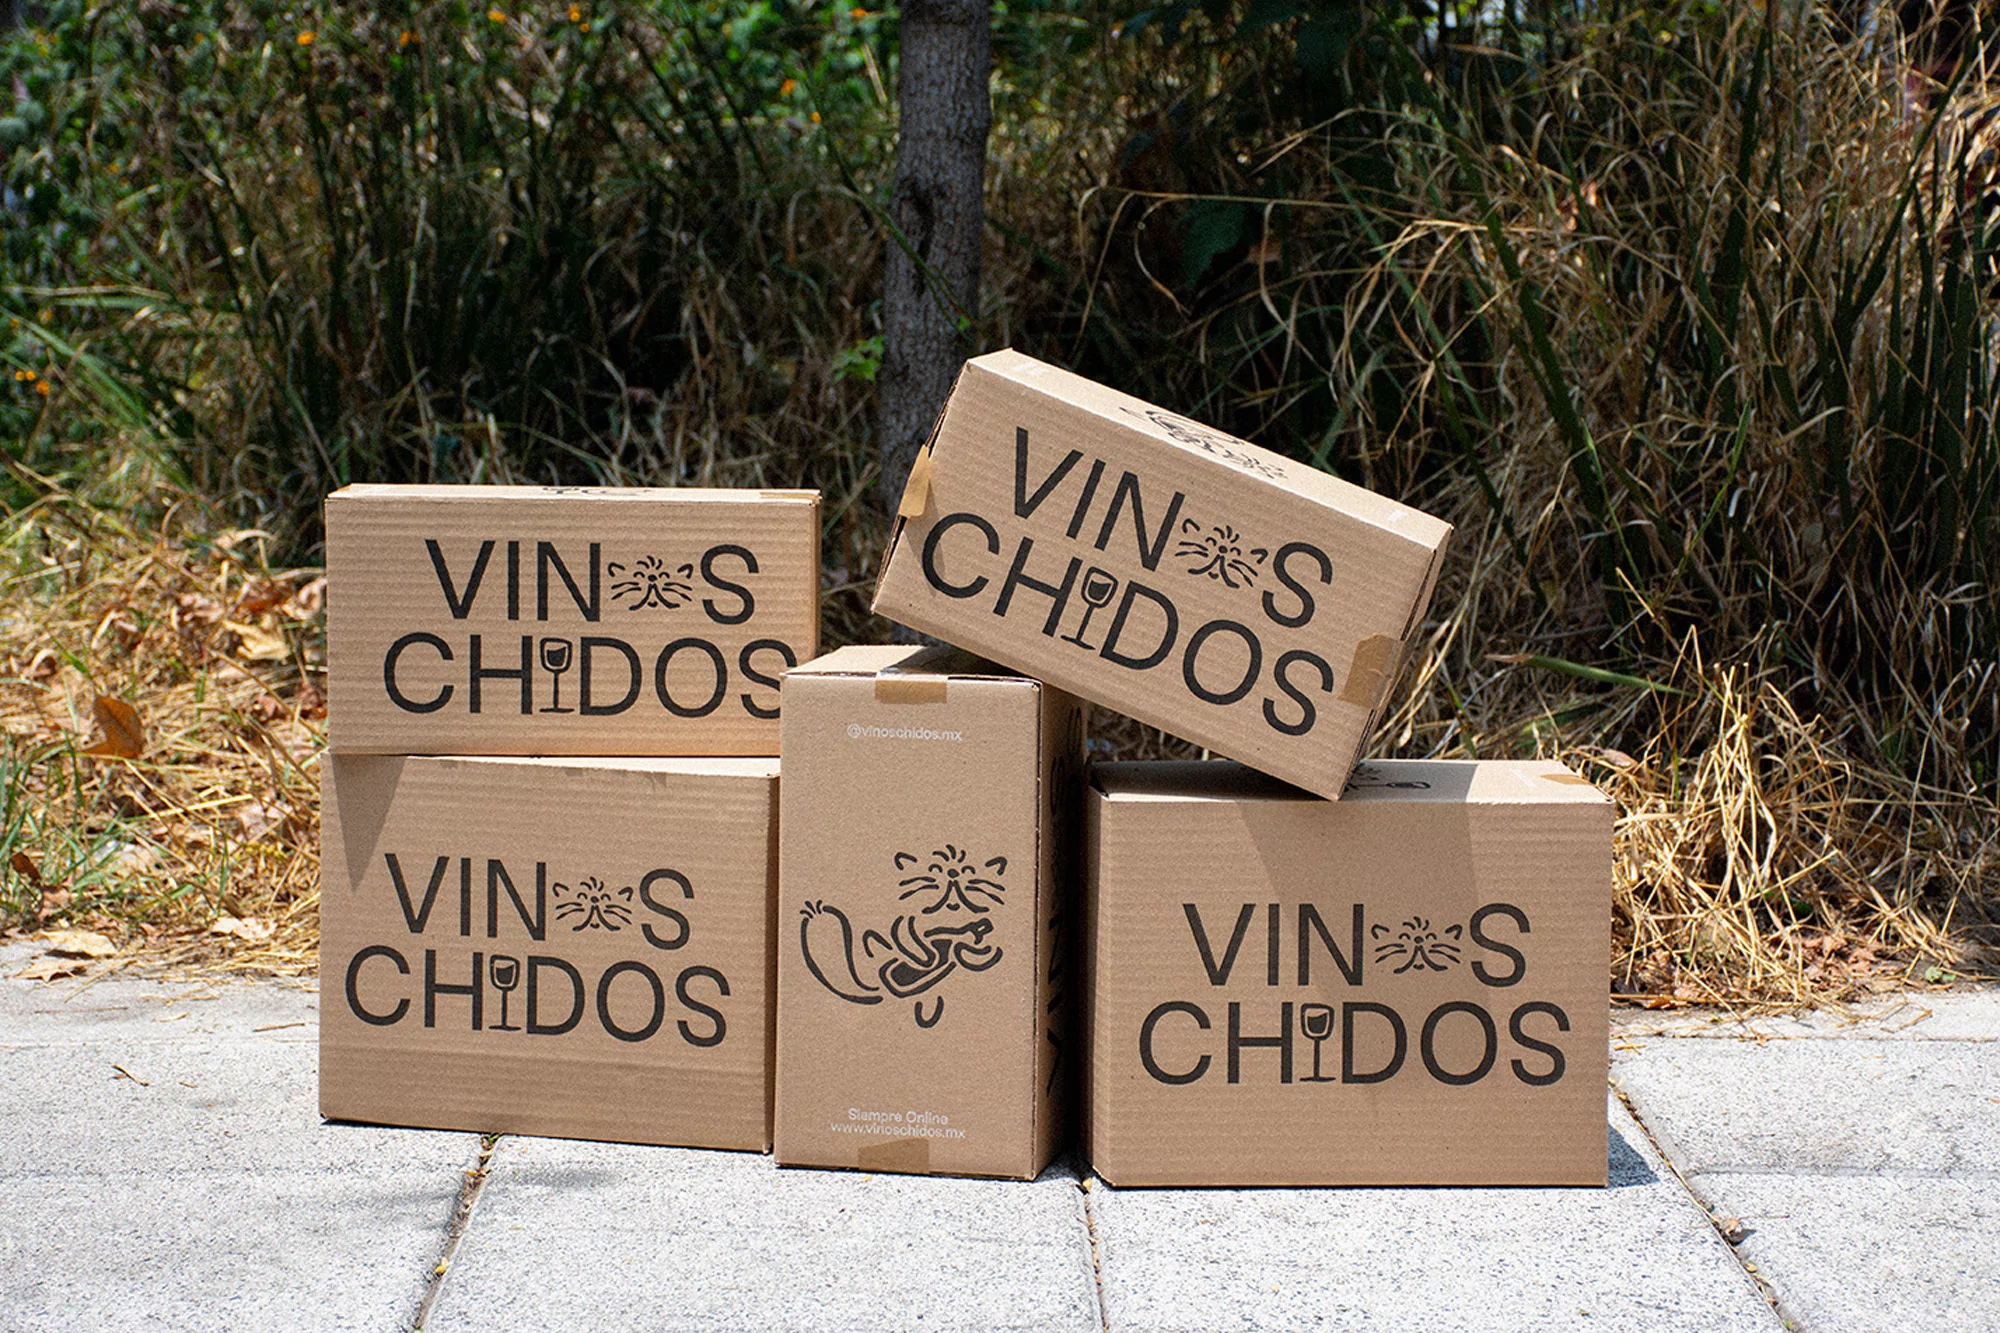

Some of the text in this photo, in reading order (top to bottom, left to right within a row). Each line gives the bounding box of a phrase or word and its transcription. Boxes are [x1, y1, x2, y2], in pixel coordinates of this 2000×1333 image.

[847, 722, 964, 741] @vinoschidos.mx
[848, 1107, 949, 1125] Siempre Online
[830, 1122, 966, 1138] www.vinoschidos.mx
